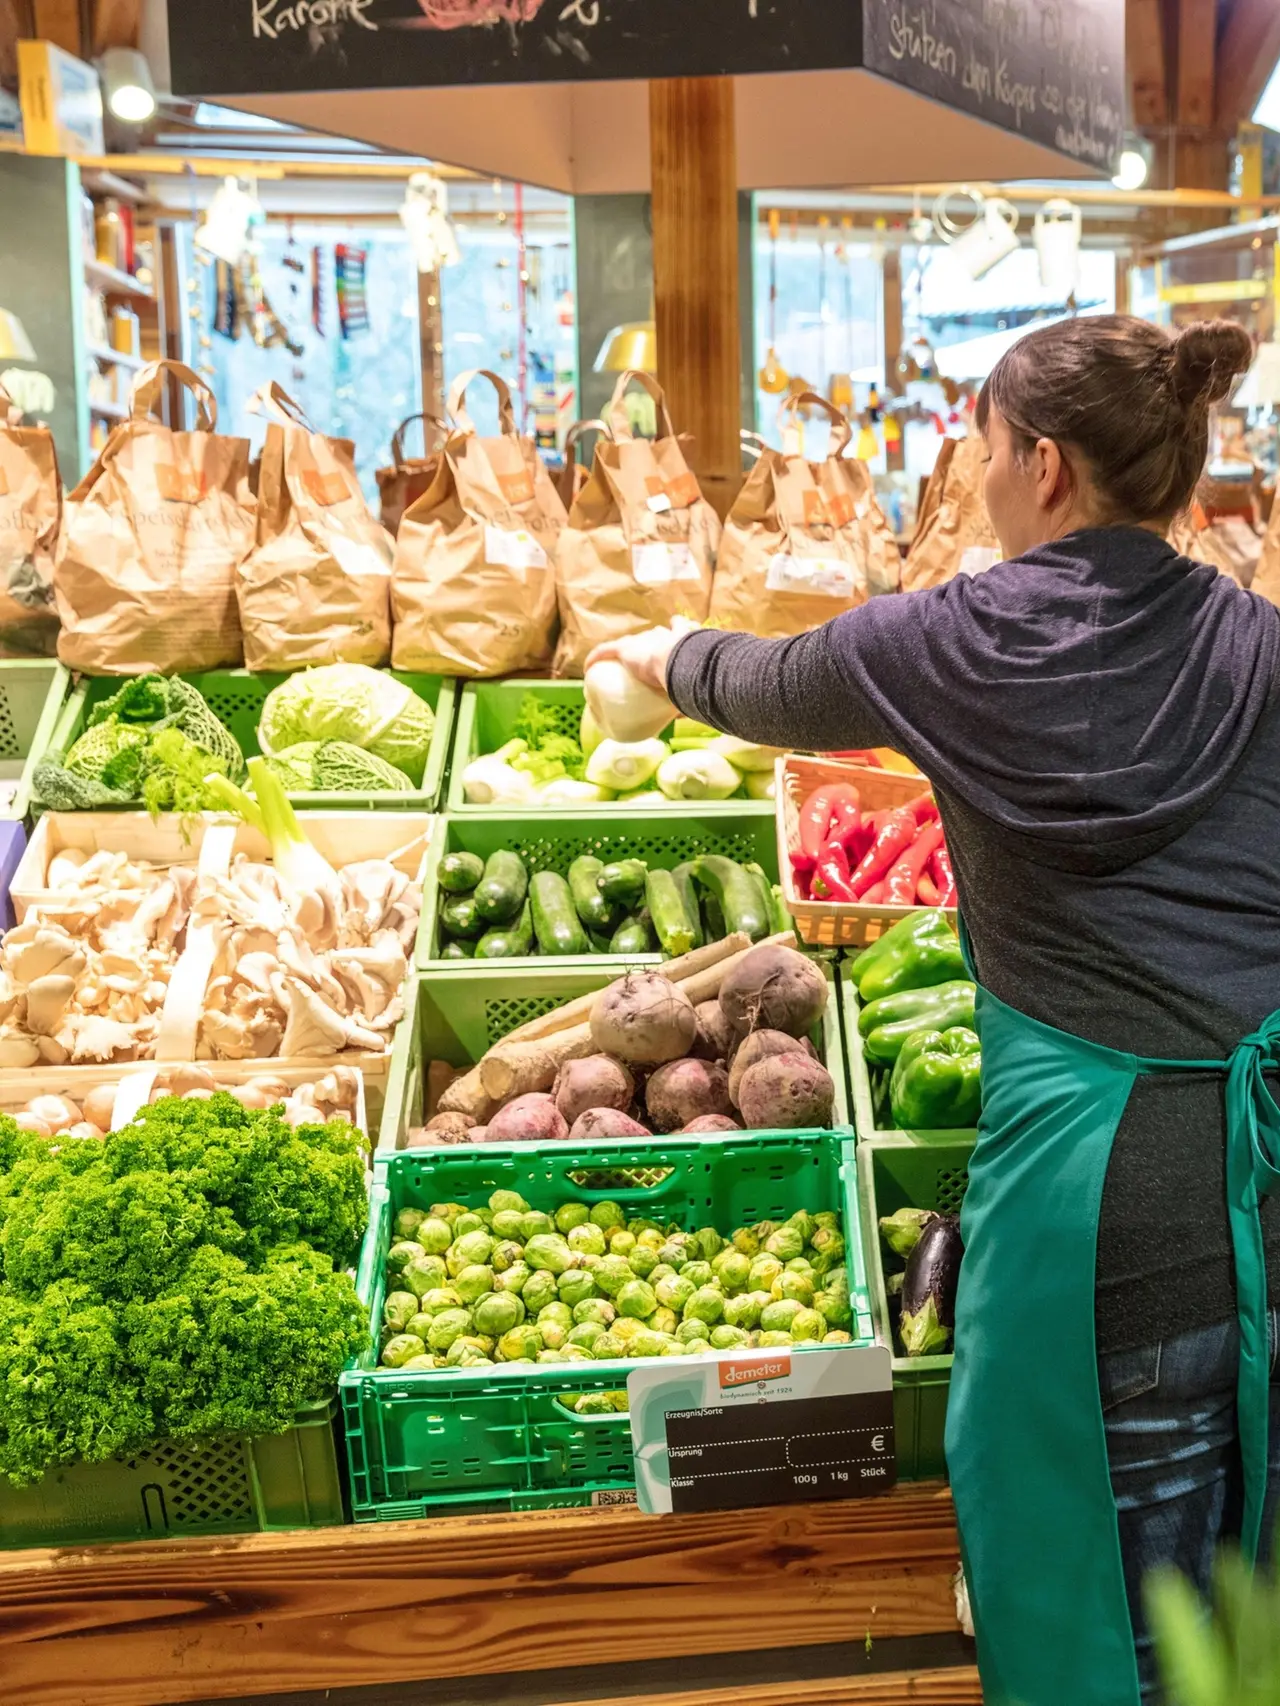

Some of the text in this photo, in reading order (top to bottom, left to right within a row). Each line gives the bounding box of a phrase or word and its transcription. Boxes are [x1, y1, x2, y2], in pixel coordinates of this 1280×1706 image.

[725, 1363, 782, 1382] demeter
[720, 1389, 763, 1399] biodynamisch
[665, 1408, 723, 1419] Erzeugnis/Sorte
[871, 1435, 885, 1451] €
[668, 1449, 703, 1458] Ursprung
[793, 1467, 886, 1484] 100 g 1 kg Stück
